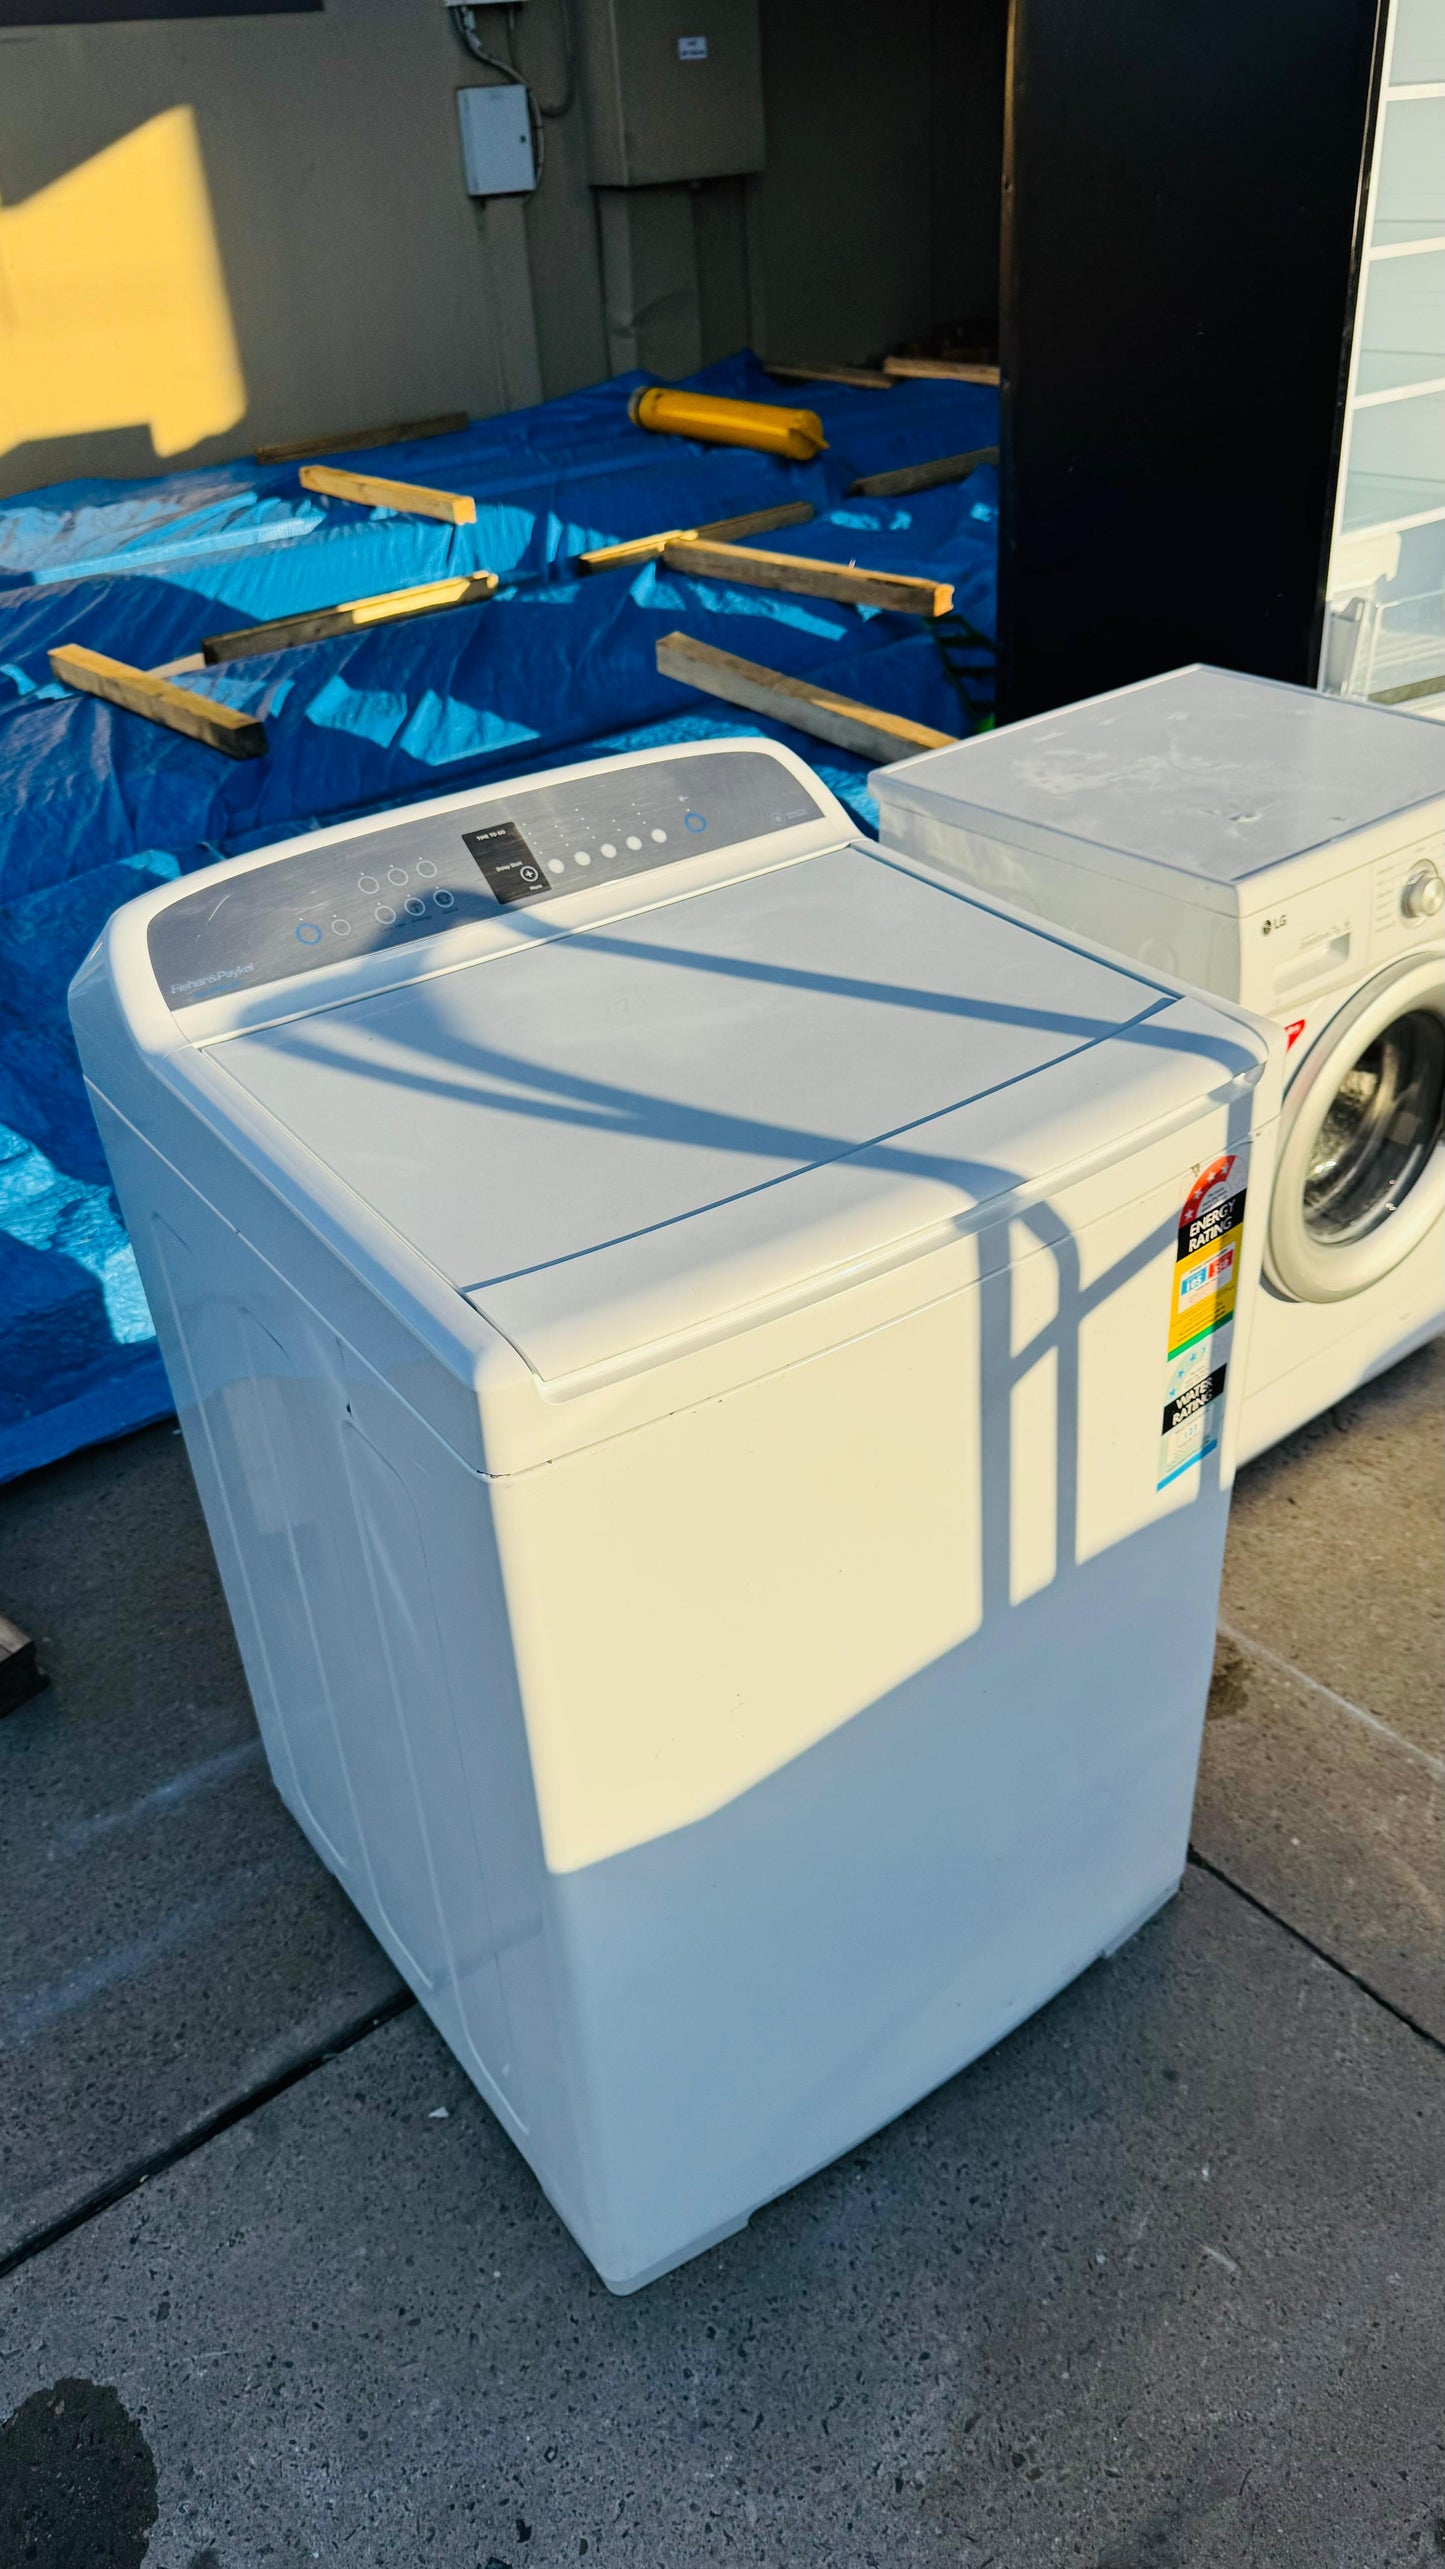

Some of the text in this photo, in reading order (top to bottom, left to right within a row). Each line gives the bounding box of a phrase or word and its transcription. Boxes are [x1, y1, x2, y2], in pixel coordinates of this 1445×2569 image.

[1273, 914, 1287, 929] LG
[1188, 1216, 1233, 1253] RATING
[1189, 1198, 1236, 1238] ENERGY
[1171, 1389, 1213, 1426] RATING
[1176, 1377, 1214, 1409] WATER
